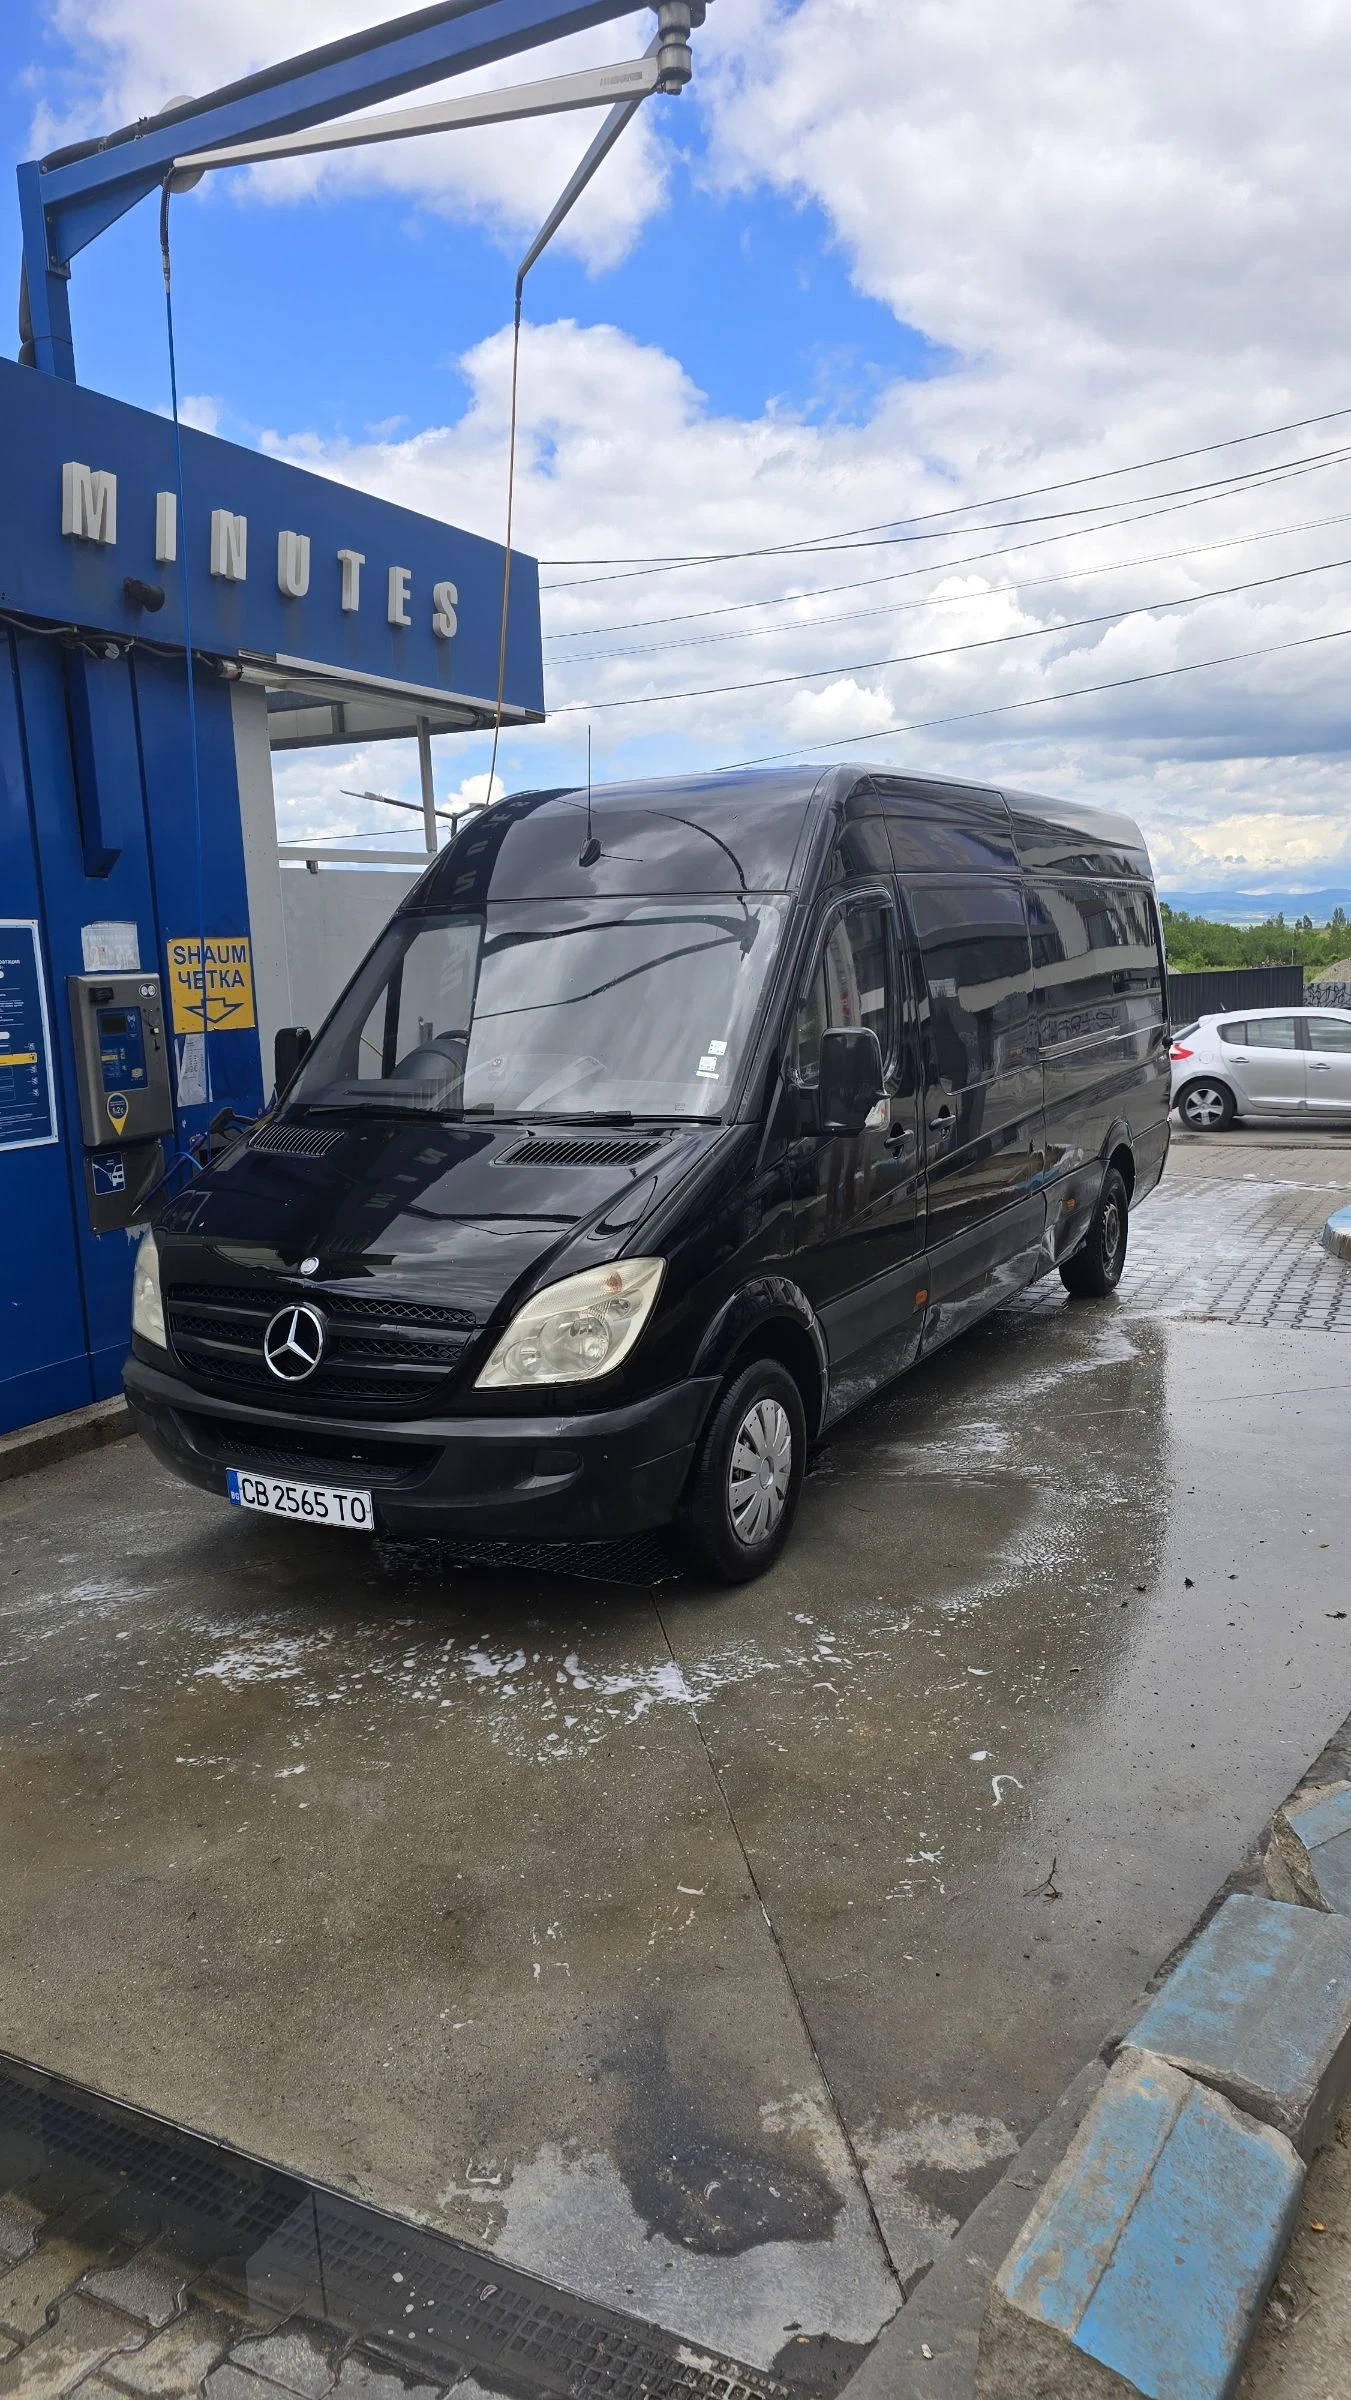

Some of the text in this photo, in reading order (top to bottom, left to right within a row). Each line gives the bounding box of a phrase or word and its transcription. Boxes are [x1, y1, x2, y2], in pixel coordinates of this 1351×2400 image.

[61, 461, 458, 639] MINUTES
[173, 945, 247, 965] SHAUM
[178, 969, 245, 990] ЧЕТКА
[231, 1491, 240, 1501] BG
[241, 1478, 269, 1507] CB
[272, 1485, 329, 1518] 2565
